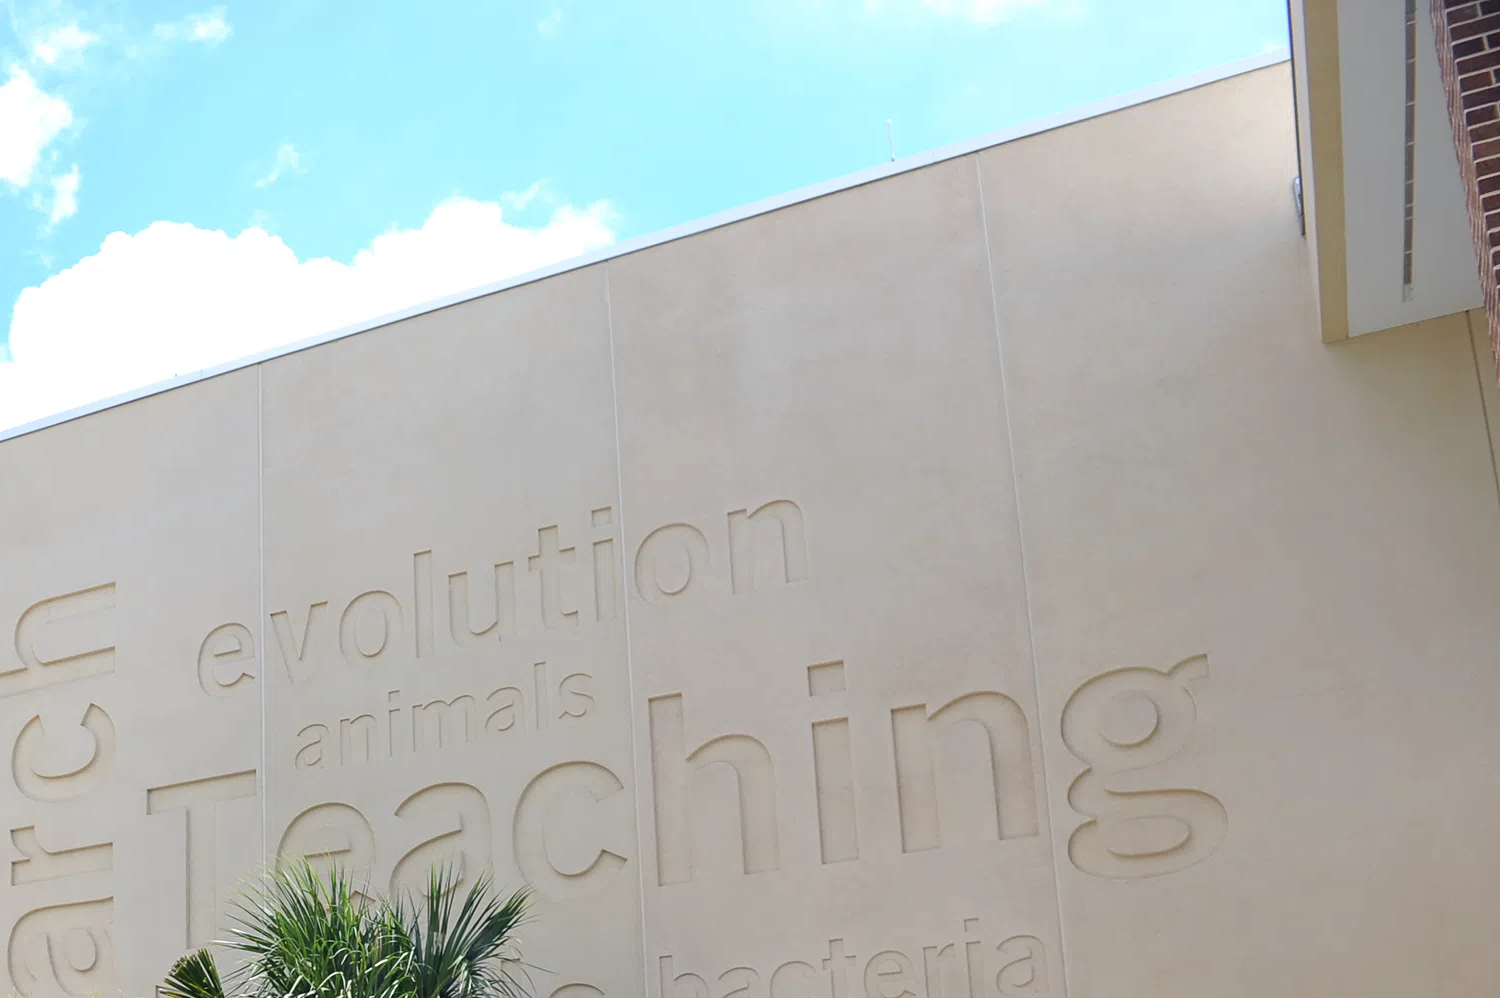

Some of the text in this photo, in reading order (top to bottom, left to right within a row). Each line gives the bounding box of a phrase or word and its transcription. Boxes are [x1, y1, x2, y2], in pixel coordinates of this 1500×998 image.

[198, 499, 808, 696] evolution
[146, 653, 1228, 950] Teaching
[294, 662, 595, 769] animals
